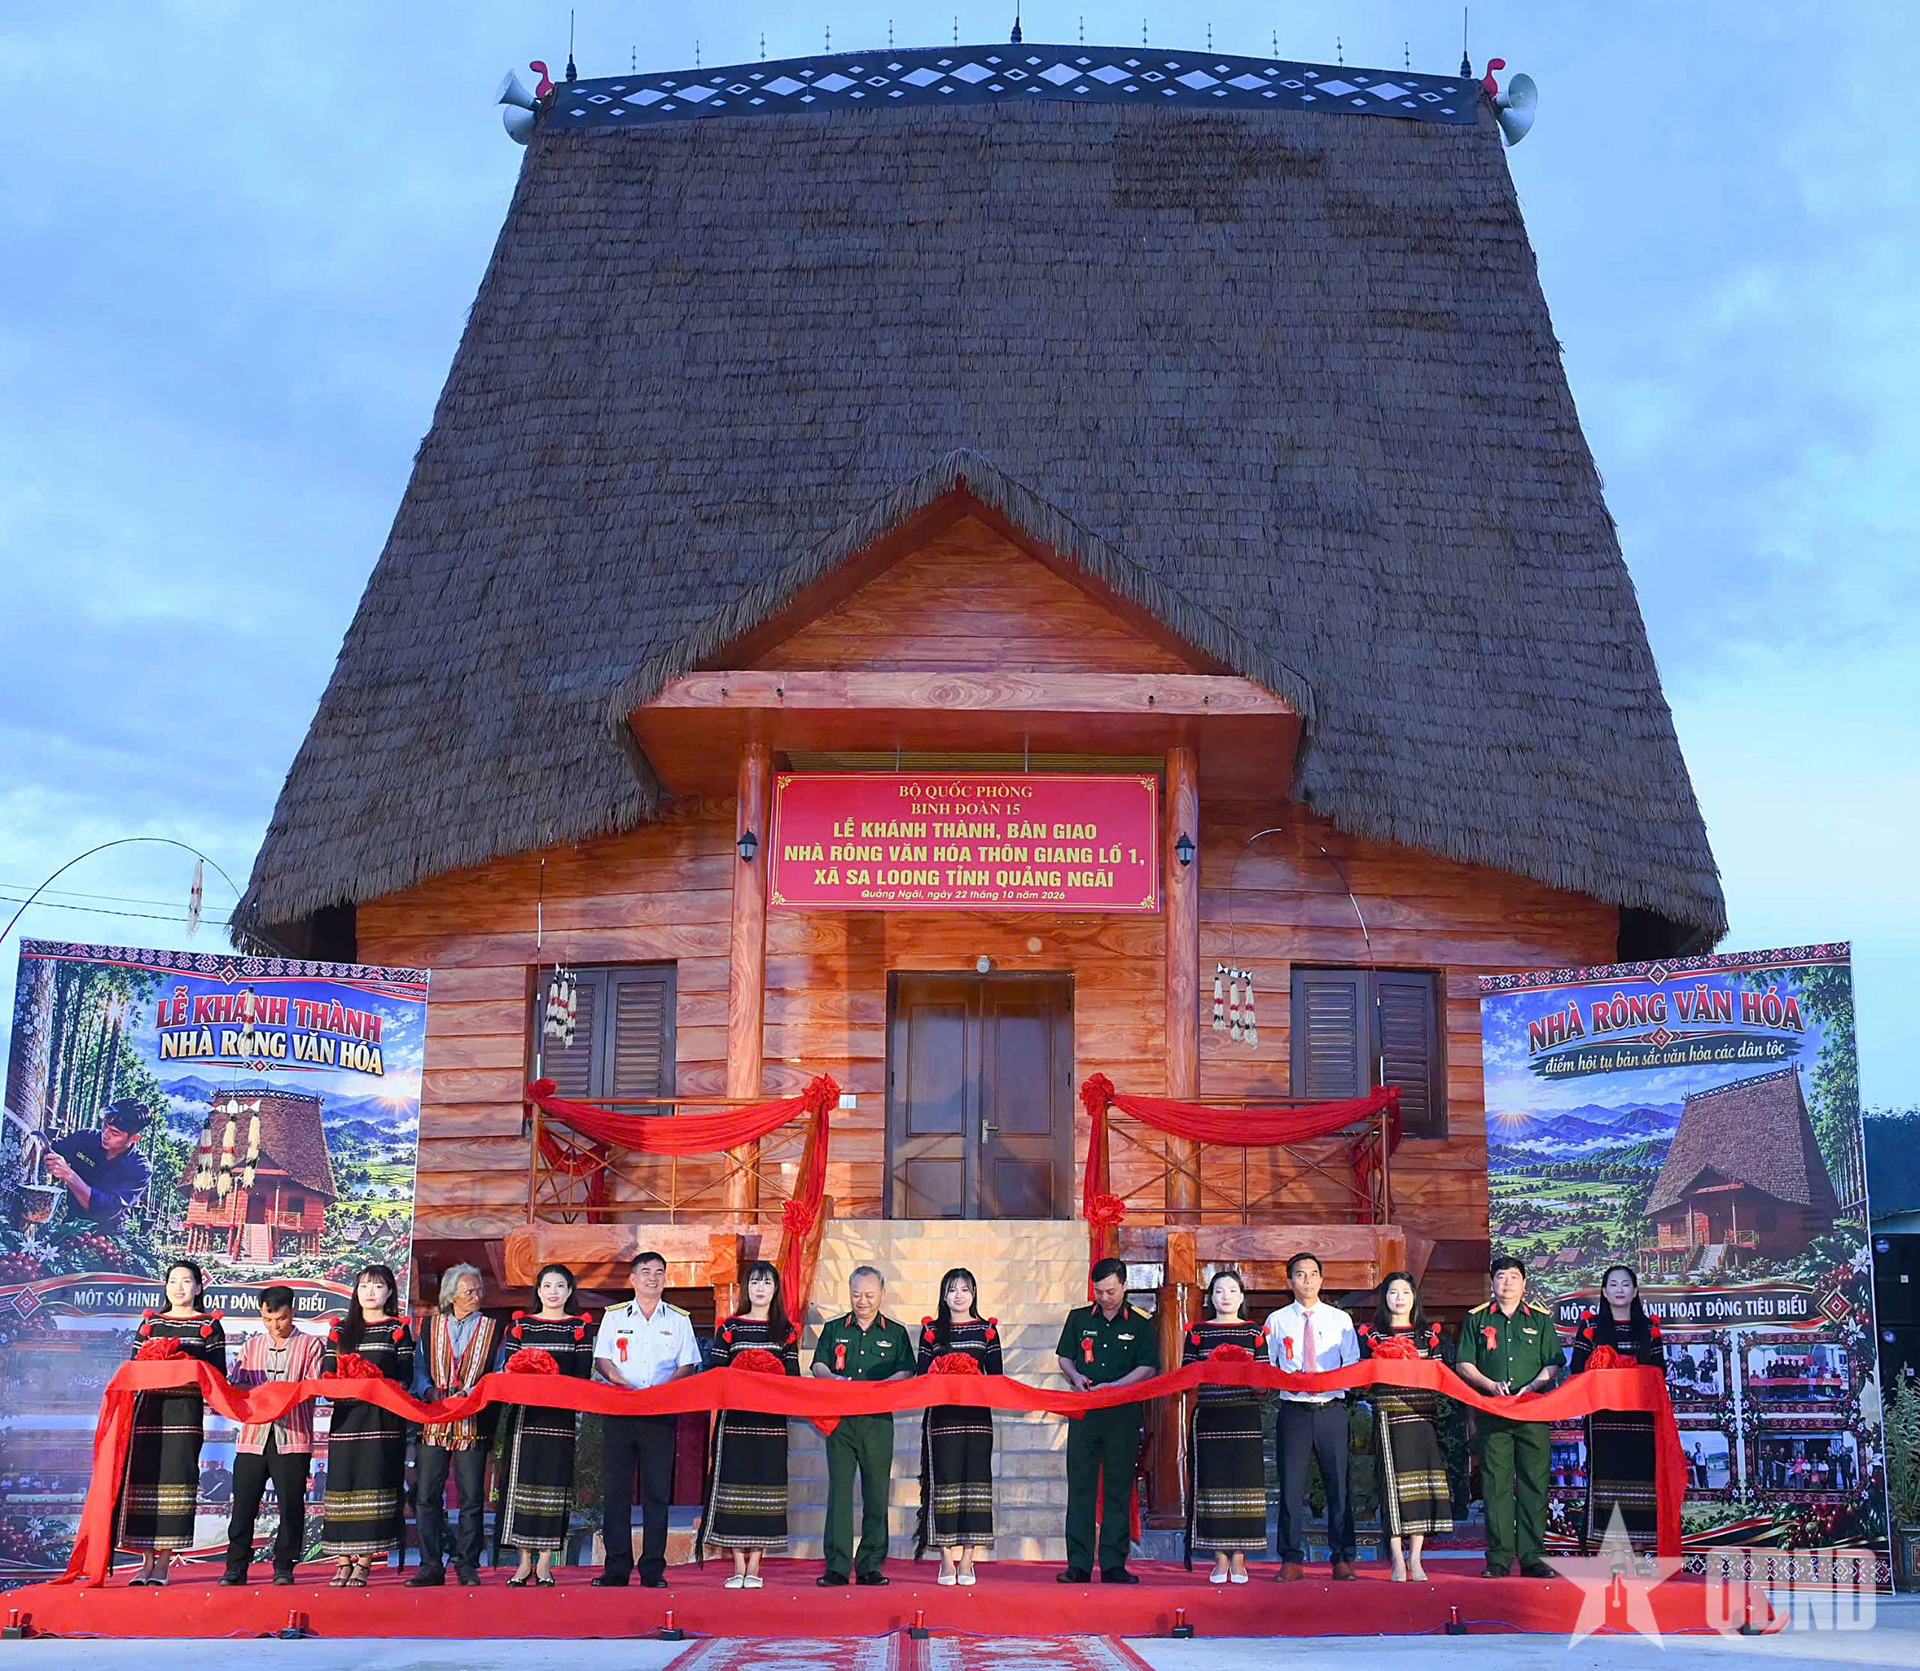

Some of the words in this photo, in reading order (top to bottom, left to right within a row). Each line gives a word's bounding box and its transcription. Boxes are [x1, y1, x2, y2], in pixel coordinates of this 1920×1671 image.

[899, 782, 921, 799] BỘ
[925, 780, 972, 799] QUỐC
[976, 783, 1032, 799] PHÒNG
[911, 803, 950, 815] BINH
[955, 801, 1000, 815] ĐOÀN
[1007, 804, 1021, 815] 15
[833, 816, 855, 838] LỄ
[861, 819, 926, 838] KHÁNH
[932, 819, 1001, 840] THÀNH,
[1007, 820, 1047, 839] BÀN
[1052, 823, 1097, 839] GIAO
[784, 843, 824, 862] NHÀ
[830, 842, 883, 862] RÔNG
[888, 843, 927, 862] VĂN
[933, 844, 972, 862] HÓA
[977, 844, 1028, 862] THÔN
[1034, 847, 1093, 863] GIANG
[1098, 842, 1122, 864] LỐ
[1128, 848, 1145, 866] 1,
[813, 866, 840, 885] XÃ
[846, 869, 870, 885] SA
[876, 869, 940, 886] LOONG
[946, 865, 990, 886] TỈNH
[995, 865, 1061, 888] QUẢNG
[1067, 868, 1114, 888] NGÃI
[861, 888, 895, 900] Quảng
[899, 889, 924, 900] Ngãi,
[927, 889, 951, 900] ngày
[955, 890, 967, 898] 22
[970, 890, 999, 901] tháng
[1002, 891, 1014, 899] 10
[1016, 890, 1038, 899] năm
[1041, 891, 1065, 900] 2026
[155, 985, 189, 1029] LỄ
[293, 999, 384, 1045] THÀNH
[1528, 1003, 1586, 1055] NHÀ
[1592, 991, 1667, 1034] RÔNG
[1673, 984, 1733, 1023] VĂN
[1740, 986, 1805, 1032] HÓA
[160, 1025, 214, 1059] NHÀ
[292, 1032, 336, 1065] VĂN
[338, 1037, 384, 1075] HÓA
[1545, 1054, 1576, 1073] điểm
[1578, 1054, 1598, 1073] hội
[1600, 1055, 1613, 1072] tụ
[1616, 1051, 1639, 1067] bản
[1641, 1047, 1661, 1065] sắc
[1663, 1048, 1686, 1064] văn
[1714, 1043, 1735, 1060] các
[1737, 1040, 1764, 1058] dân
[1766, 1040, 1786, 1059] tộc
[73, 1288, 104, 1309] MỘT
[106, 1287, 126, 1306] SỐ
[127, 1290, 160, 1307] HÌNH
[298, 1292, 327, 1312] BIỂU
[1669, 1302, 1702, 1321] HOẠT
[1705, 1298, 1742, 1320] ĐỘNG
[1745, 1297, 1774, 1316] TIÊU
[1777, 1293, 1808, 1315] BIỂU
